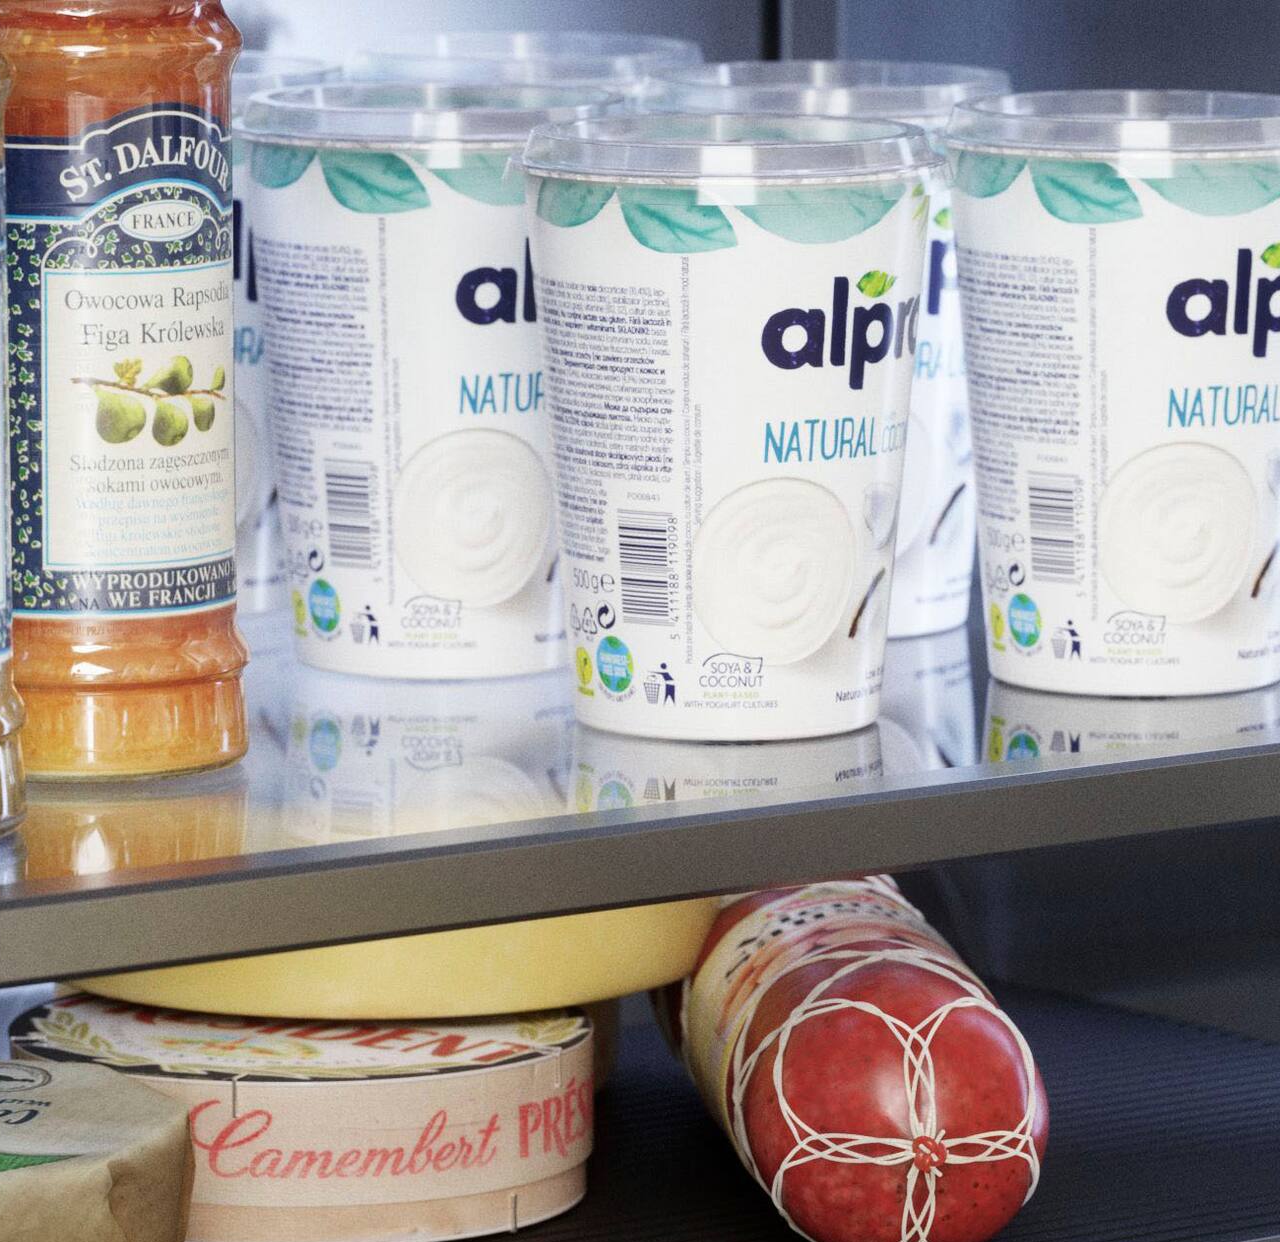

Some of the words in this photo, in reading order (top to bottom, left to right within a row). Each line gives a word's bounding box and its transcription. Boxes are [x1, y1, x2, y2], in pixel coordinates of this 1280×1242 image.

[59, 158, 112, 201] ST.
[113, 136, 230, 192] DALFOUR
[132, 211, 197, 230] FRANCE
[64, 289, 164, 311] Owocowa
[83, 323, 130, 351] Figa
[141, 315, 224, 344] Królewska
[1168, 384, 1280, 428] NATURAL
[764, 417, 878, 464] NATURAL
[72, 562, 230, 591] WYPRODUKOWANO
[108, 591, 142, 609] WE
[149, 582, 215, 606] FRANCJI
[1103, 632, 1167, 645] COCONUT
[698, 675, 764, 688] COCONUT
[710, 662, 741, 675] SOYA
[743, 662, 753, 675] &
[684, 700, 704, 709] WITH
[743, 700, 779, 709] CULTURES
[189, 1100, 501, 1180] Camembert
